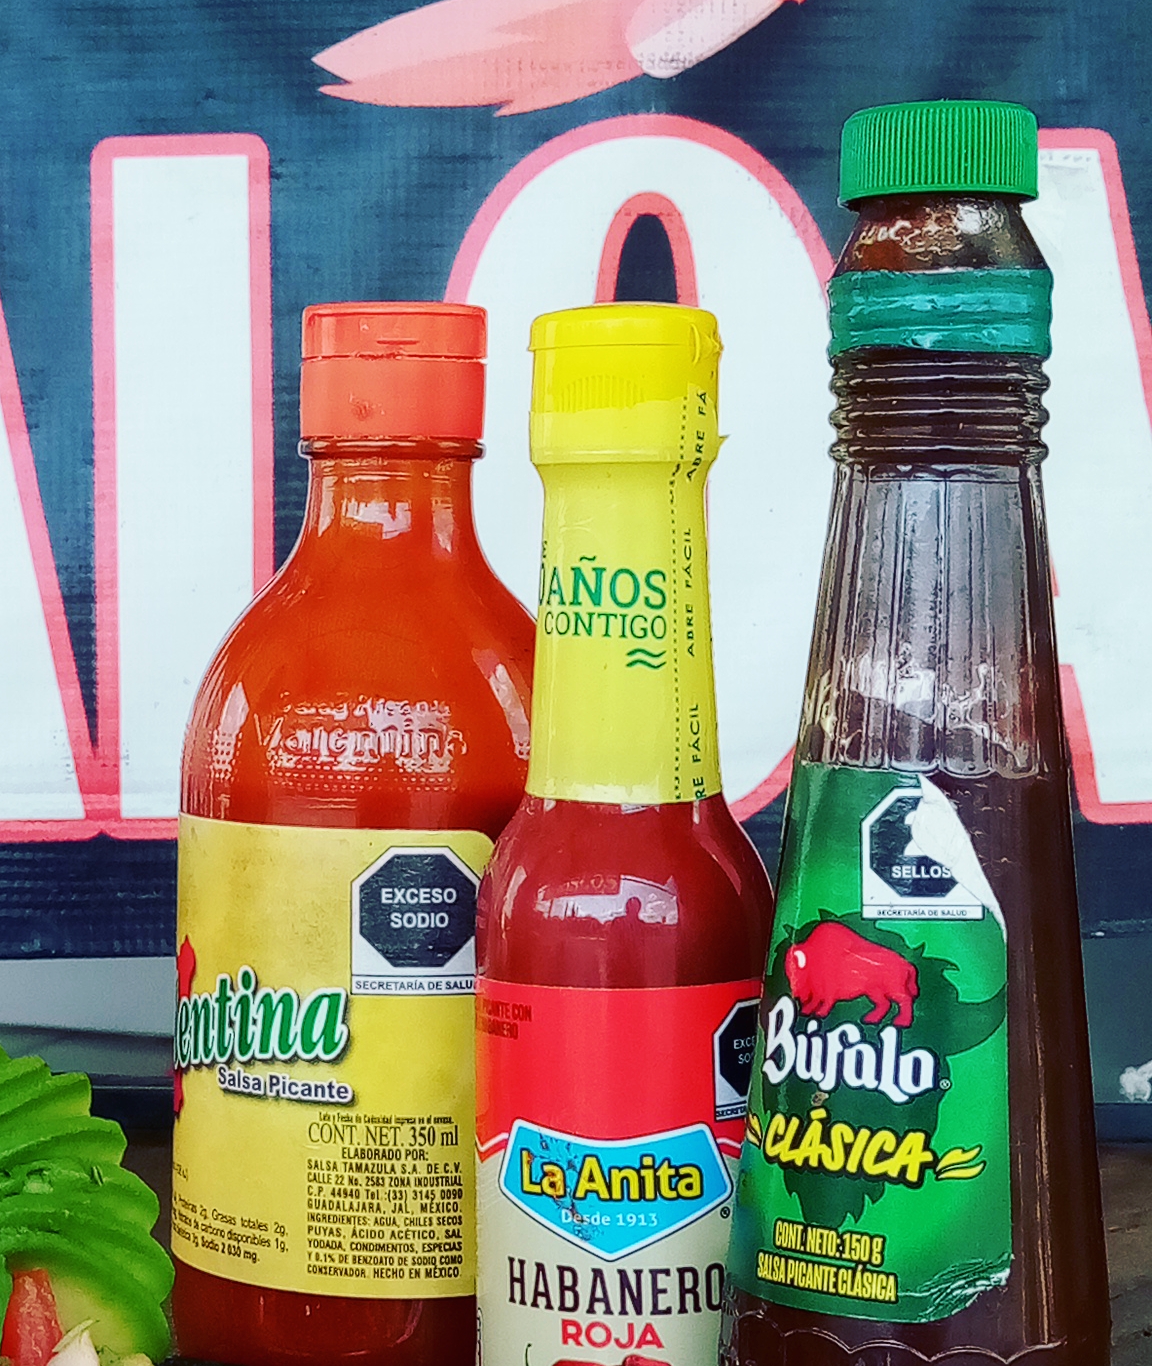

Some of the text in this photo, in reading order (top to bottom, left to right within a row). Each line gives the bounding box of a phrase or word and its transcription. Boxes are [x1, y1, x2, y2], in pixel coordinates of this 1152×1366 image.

[687, 430, 705, 482] ABRE
[547, 555, 667, 609] AÑOS
[683, 527, 696, 658] ABRE FÁCIL
[544, 611, 667, 640] CONTIGO
[689, 704, 700, 764] FÁCIL
[891, 865, 952, 878] SELLOS
[381, 887, 457, 904] EXCESO
[390, 912, 448, 928] SODIO
[877, 908, 967, 917] SECRETARÍA DE SALUD
[355, 979, 474, 991] SECRETARÍA DE SALU
[175, 967, 350, 1069] entina
[733, 1035, 757, 1050] EXCE
[762, 995, 935, 1103] Búfalo
[218, 1066, 350, 1101] Salsa Picante
[308, 1122, 458, 1147] CONT. NET. 350 ml
[764, 1107, 934, 1182] CLÁSICA
[341, 1147, 429, 1161] ELABORADO POR:
[307, 1159, 338, 1172] SALSA
[344, 1162, 396, 1175] TAMAZULA
[427, 1163, 440, 1174] DE
[520, 1149, 703, 1201] La Anita
[307, 1172, 332, 1184] CALLE
[335, 1173, 344, 1185] 22
[389, 1176, 411, 1187] ZONA
[414, 1176, 463, 1187] INDUSTRIAL
[331, 1187, 360, 1199] 44940
[211, 1208, 237, 1226] Grasas
[240, 1216, 269, 1233] totales
[404, 1217, 433, 1227] CHILES
[436, 1215, 463, 1226] SECOS
[561, 1210, 658, 1227] Desde 1913
[444, 1229, 463, 1239] SAL
[775, 1220, 884, 1265] CONT. NETO: 150 g
[422, 1241, 463, 1252] ESPECIAS
[339, 1254, 349, 1264] DE
[352, 1255, 395, 1266] BENZOATO
[398, 1255, 409, 1266] DE
[411, 1256, 437, 1266] SODIO
[440, 1254, 463, 1265] COMO
[373, 1267, 405, 1279] HECHO
[409, 1268, 421, 1279] EN
[757, 1252, 897, 1302] SALSA PICANTE CLÁSICA
[508, 1256, 725, 1316] HABANERO
[561, 1318, 665, 1349] ROJA
